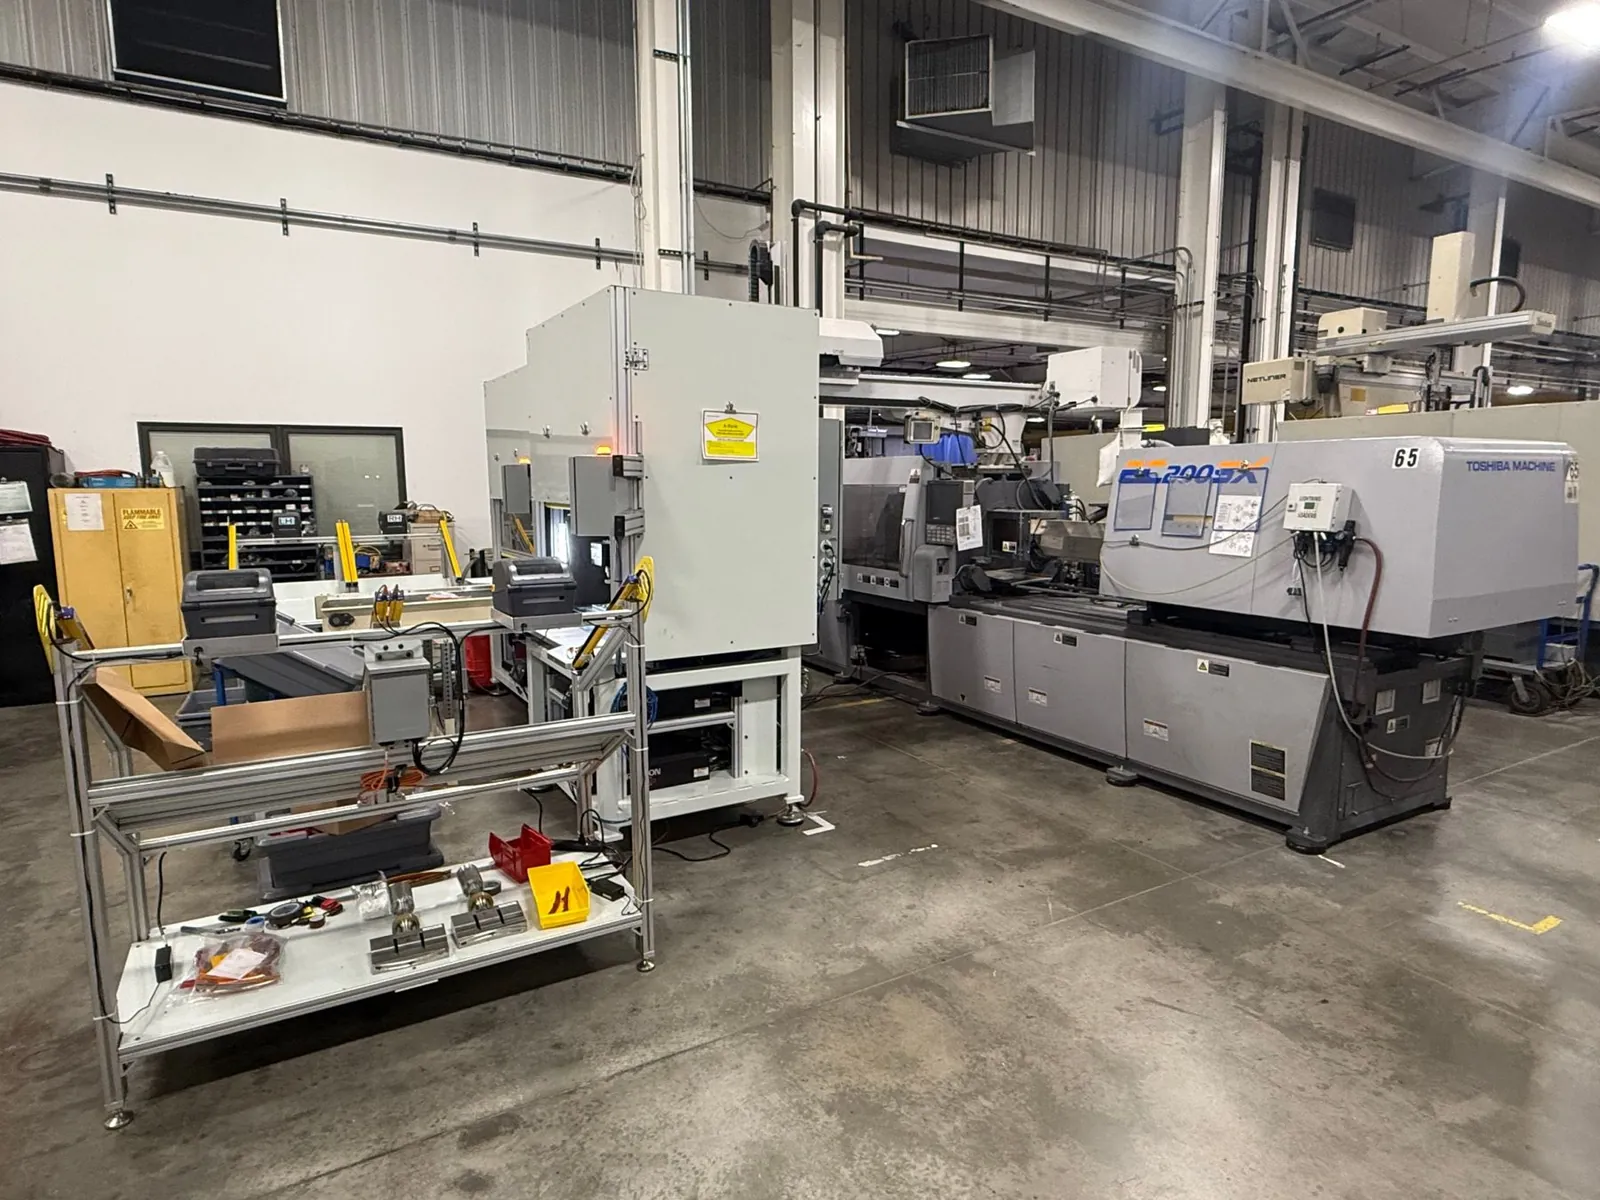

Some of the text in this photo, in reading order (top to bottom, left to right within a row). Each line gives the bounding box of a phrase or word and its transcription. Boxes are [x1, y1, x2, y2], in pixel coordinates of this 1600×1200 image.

[1246, 373, 1287, 383] NETLINER
[1394, 448, 1419, 467] 65
[1466, 461, 1556, 472] TOSHIBA MACHINE
